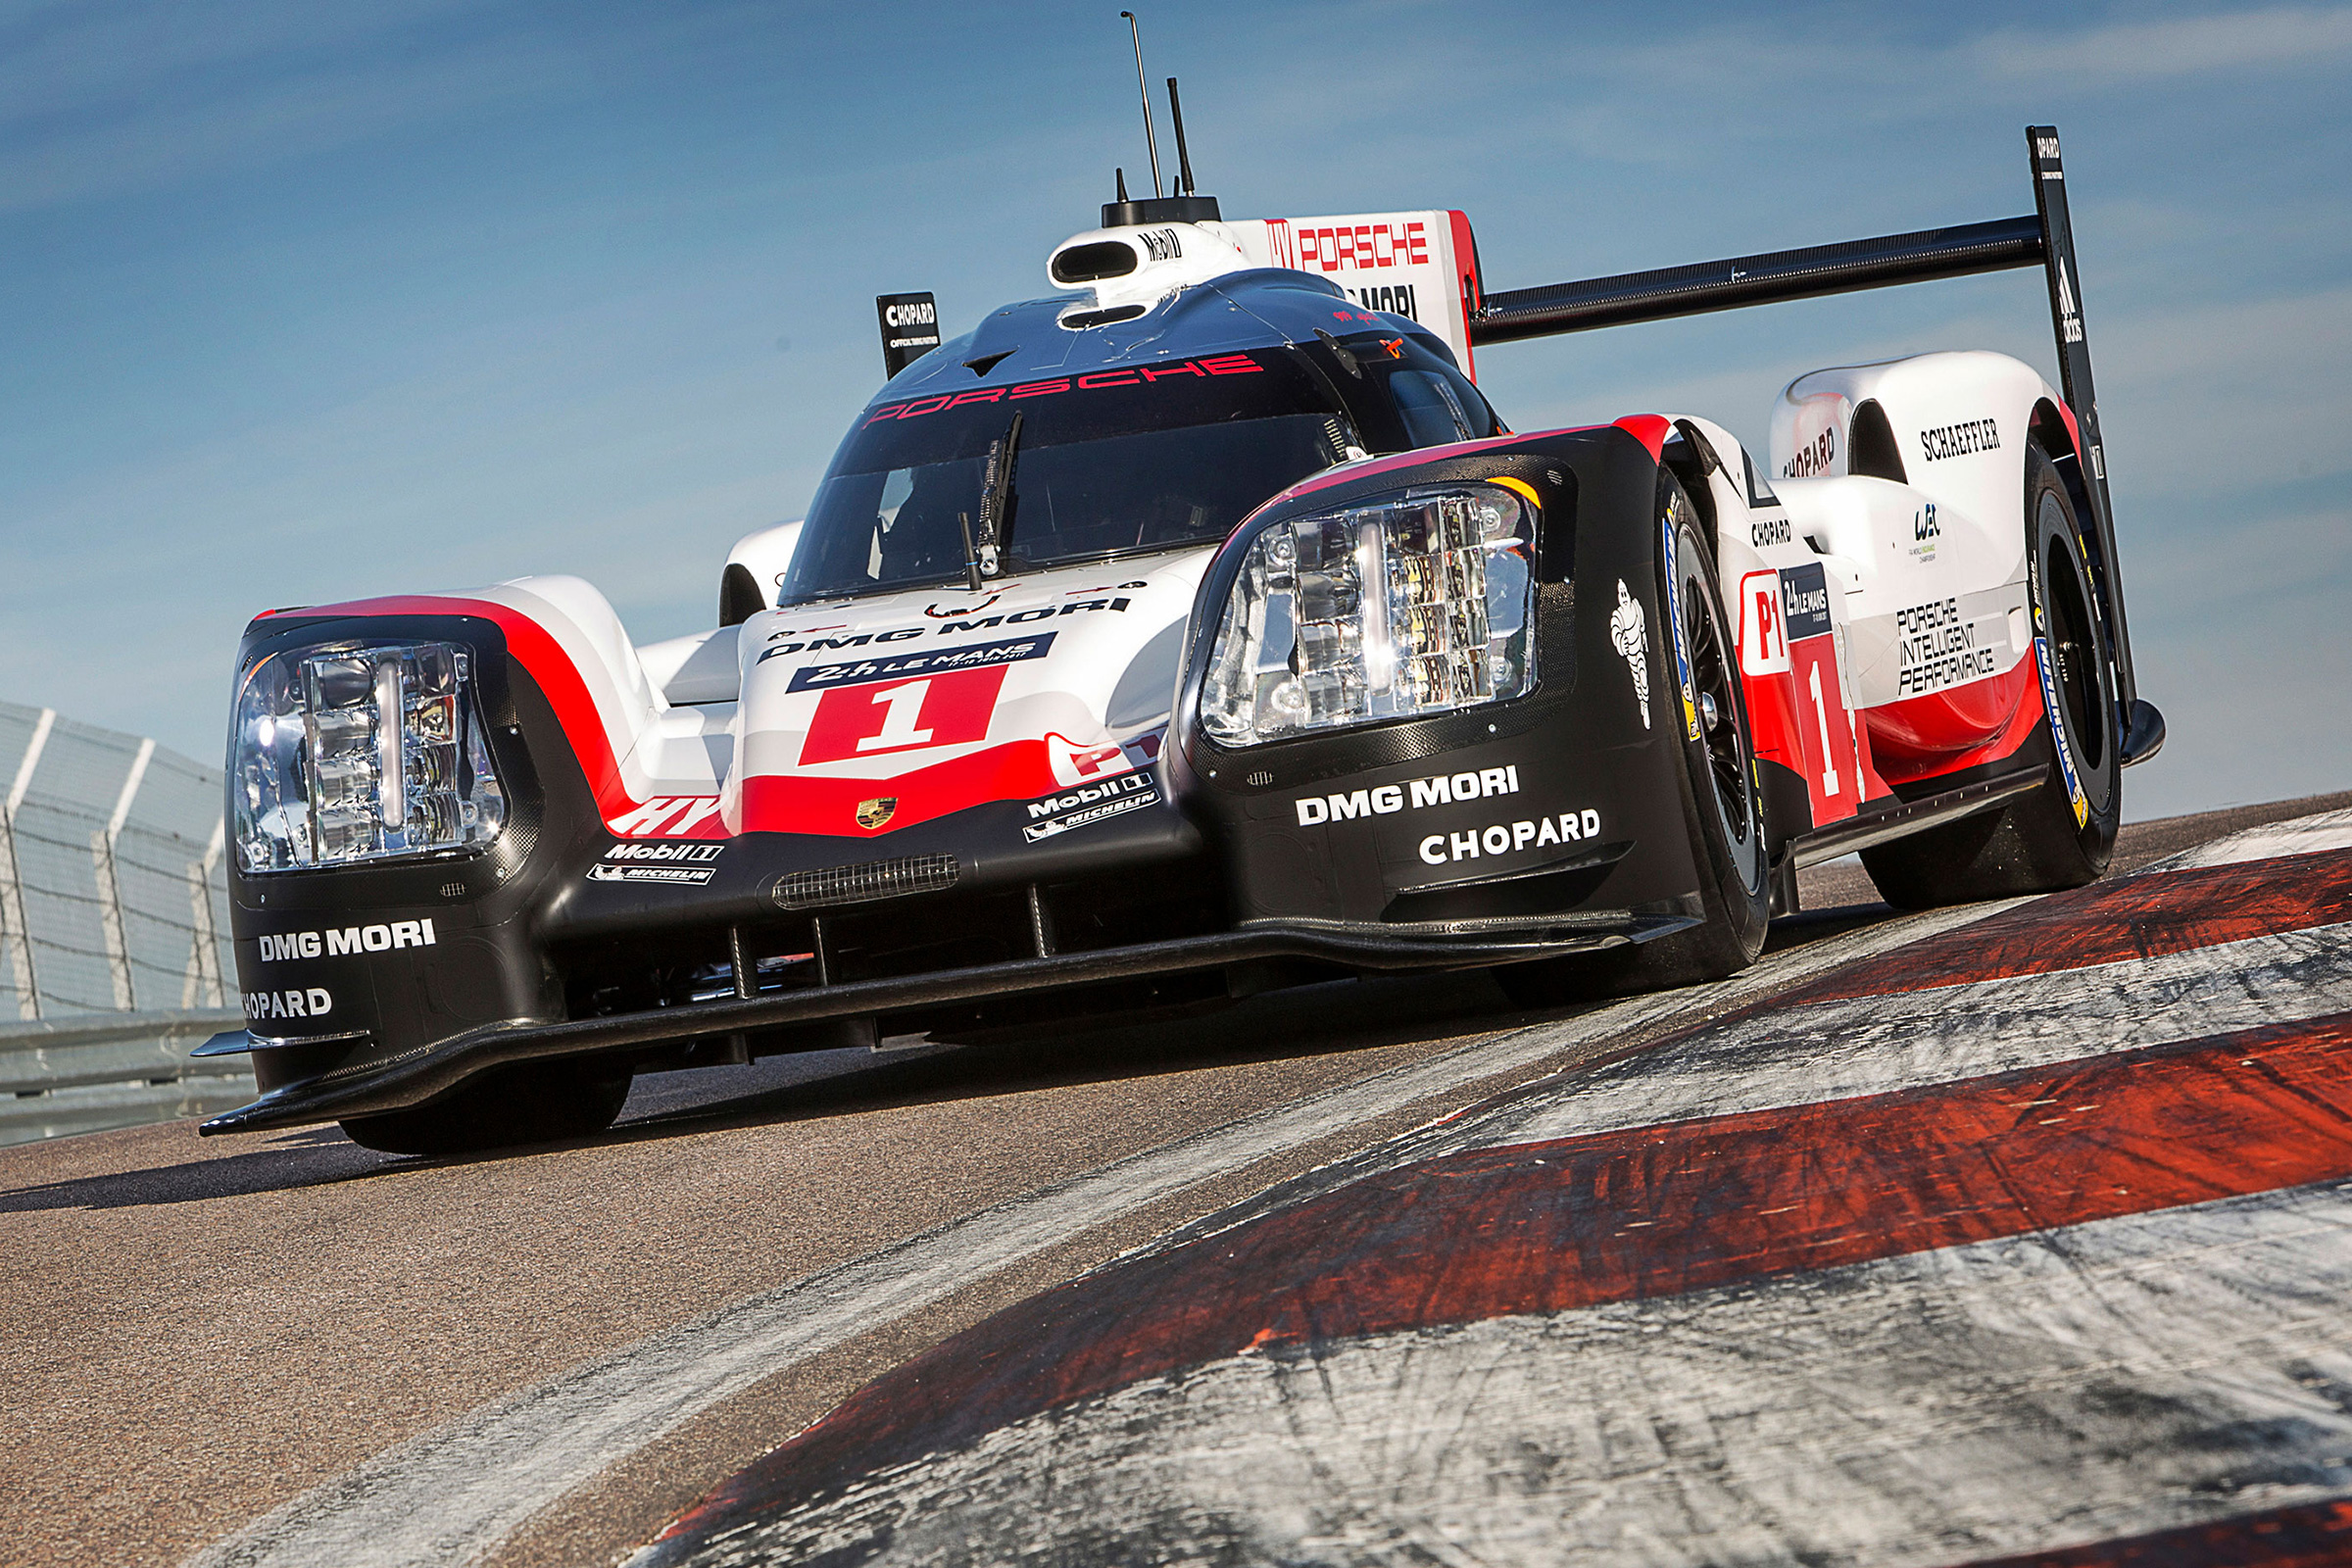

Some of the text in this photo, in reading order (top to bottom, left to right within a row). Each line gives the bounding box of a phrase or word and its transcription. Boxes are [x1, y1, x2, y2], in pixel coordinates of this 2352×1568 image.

[2036, 137, 2060, 159] OPARD
[1138, 229, 1173, 261] Mobil
[1298, 221, 1429, 271] PORSCHE
[885, 302, 936, 327] CHOPARD
[861, 354, 1264, 429] PORSCHE
[1920, 417, 2001, 462] SCHAEFFLER
[1751, 519, 1791, 547] CHOPARD
[756, 597, 1131, 665] DMG MORI
[1755, 590, 1785, 660] P1
[1896, 597, 1958, 637] PORSCHE
[882, 658, 930, 673] LE
[931, 643, 1036, 666] MANS
[1899, 622, 1975, 666] INTELLIGENT
[1898, 648, 1994, 696] PERFORMANCE
[856, 679, 934, 752] 1
[1808, 660, 1840, 797] 1
[2040, 643, 2076, 774] MICHELIN
[1027, 780, 1121, 819] Mobil
[1065, 792, 1155, 825] MICHELIN
[1295, 764, 1520, 827] DMG MORI
[604, 844, 695, 860] Mobil
[1418, 808, 1601, 865] CHOPARD
[625, 868, 710, 880] MICHELIN
[259, 918, 437, 962] DMG MORI
[243, 987, 333, 1020] HOPARD
